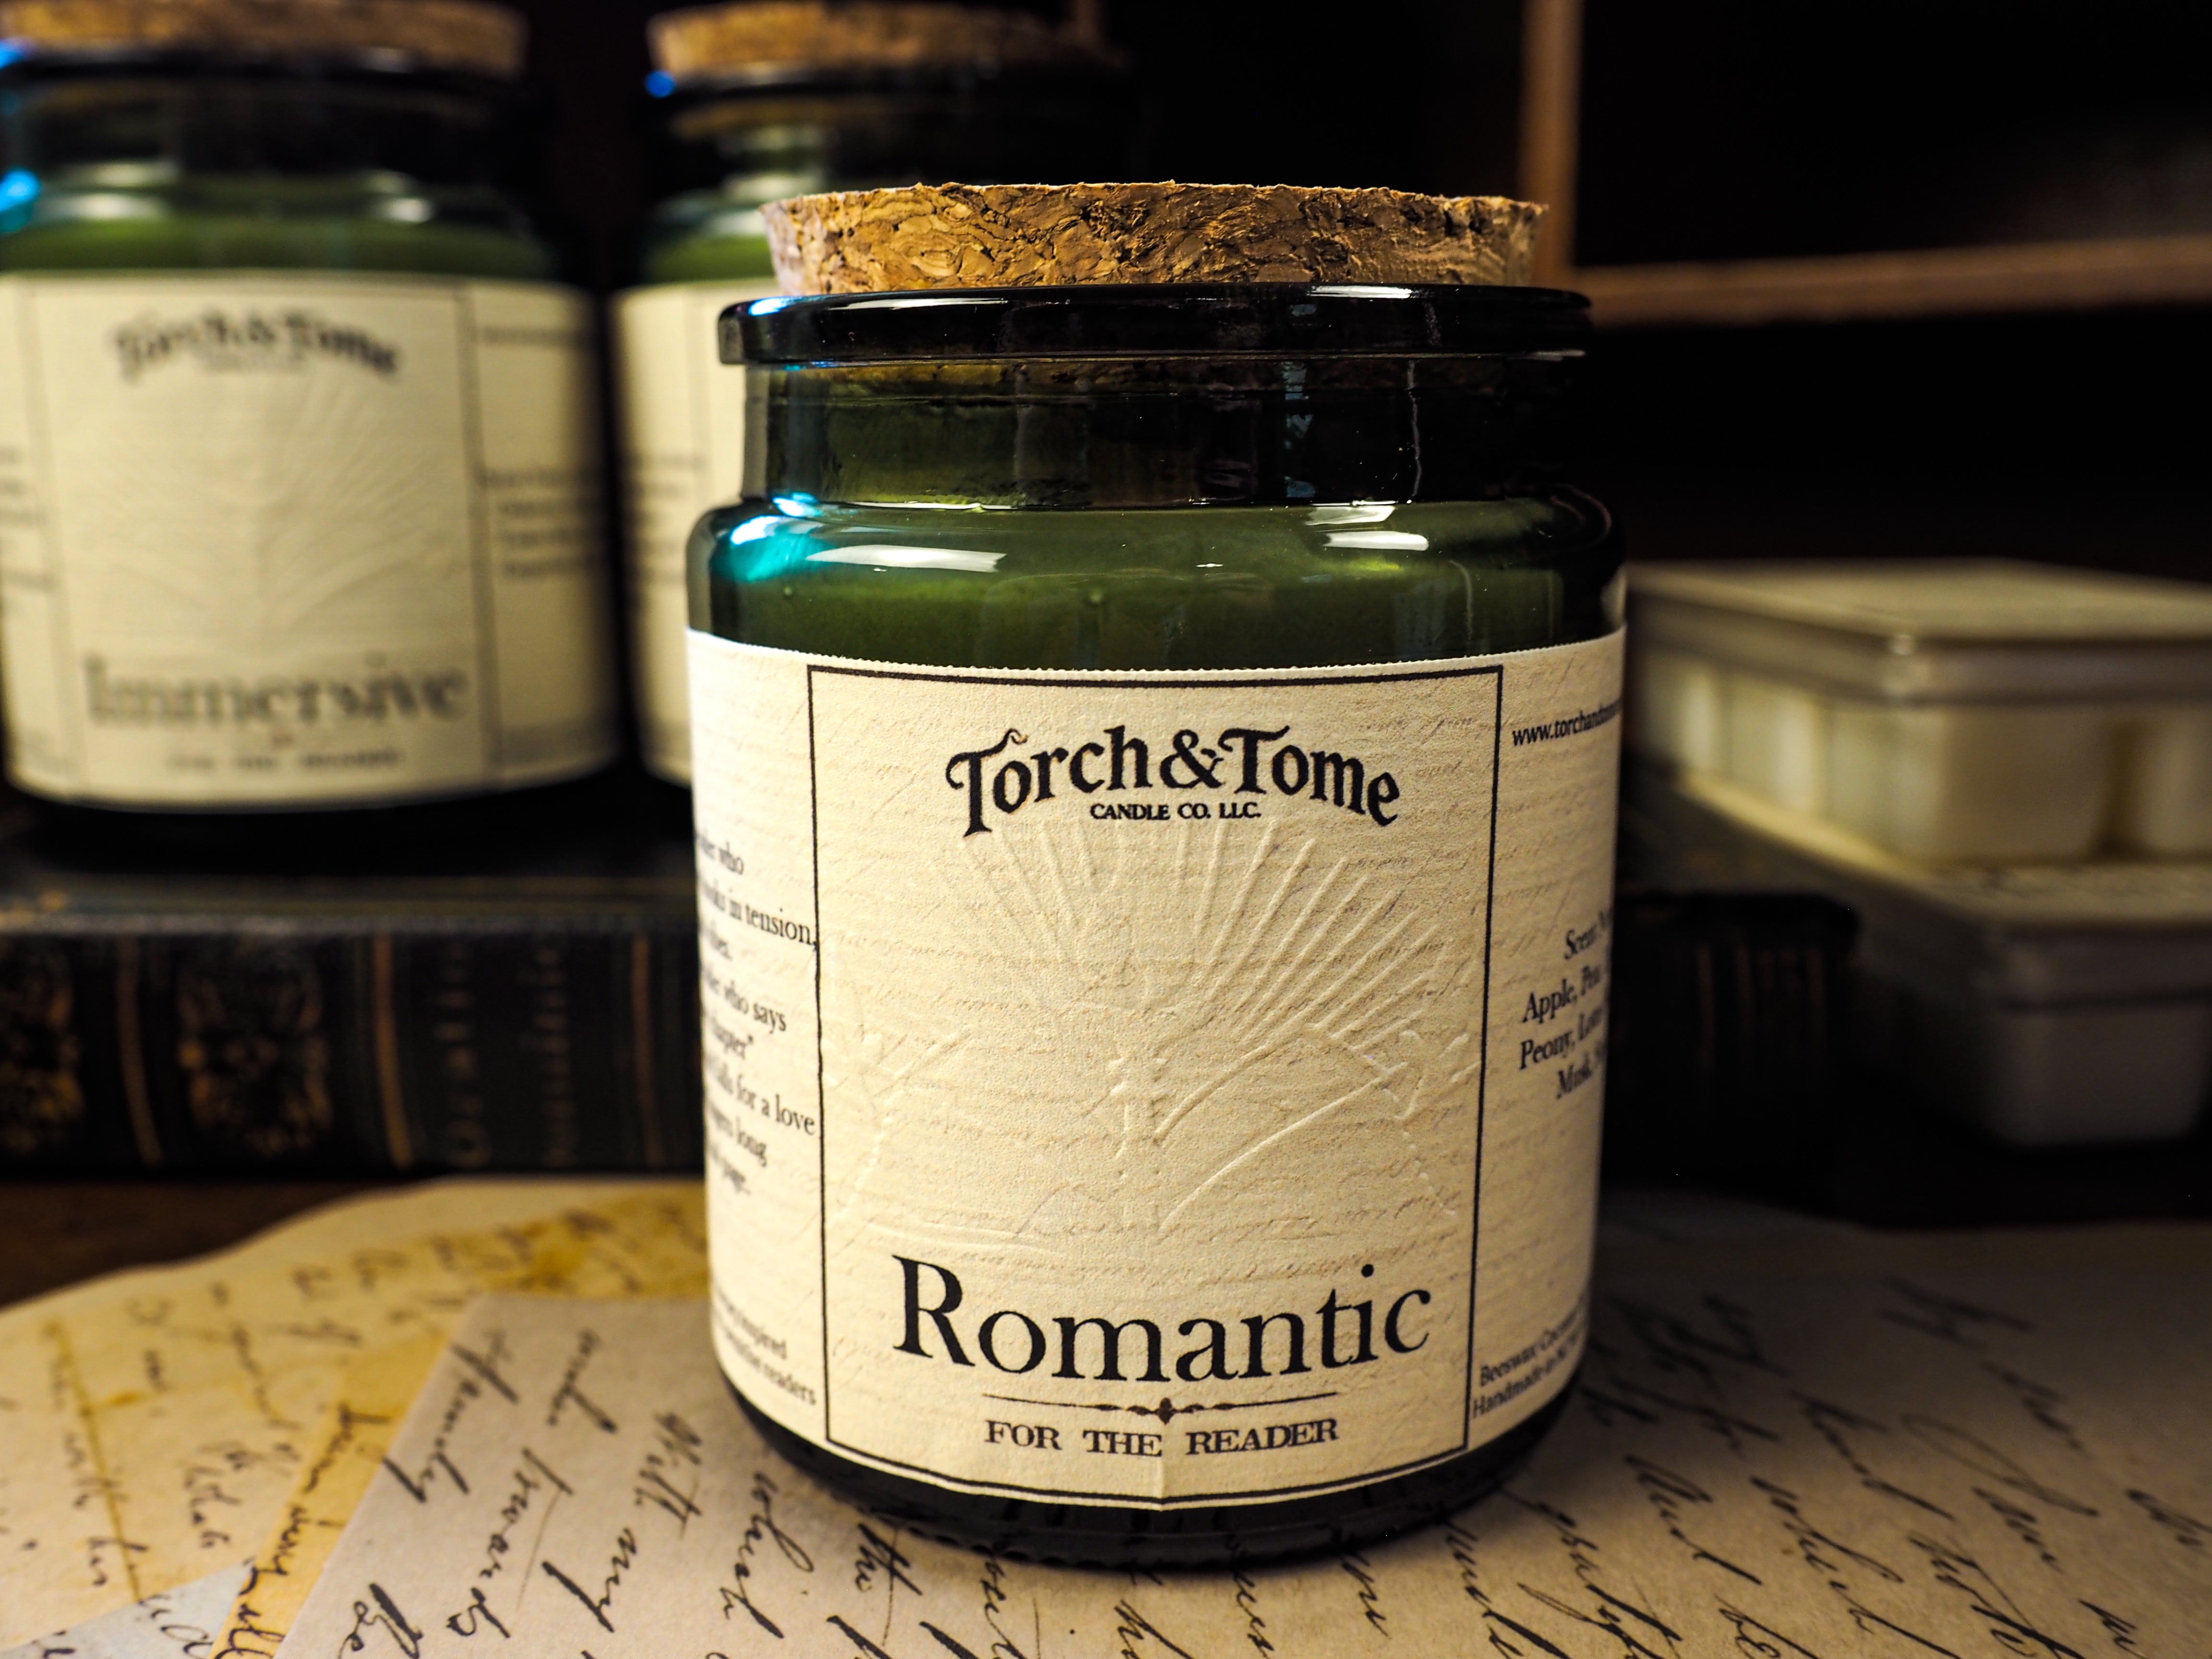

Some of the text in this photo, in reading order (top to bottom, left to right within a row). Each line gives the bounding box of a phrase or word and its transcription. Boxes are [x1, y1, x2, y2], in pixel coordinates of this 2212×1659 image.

[945, 725, 1400, 837] Torch&Tome
[1090, 802, 1262, 820] CANDLE CO. LLC.
[745, 903, 817, 952] tension,
[752, 1002, 787, 1034] says
[775, 1093, 816, 1136] love
[891, 1254, 1432, 1382] Romantic
[984, 1418, 1340, 1457] FOR THE READER
